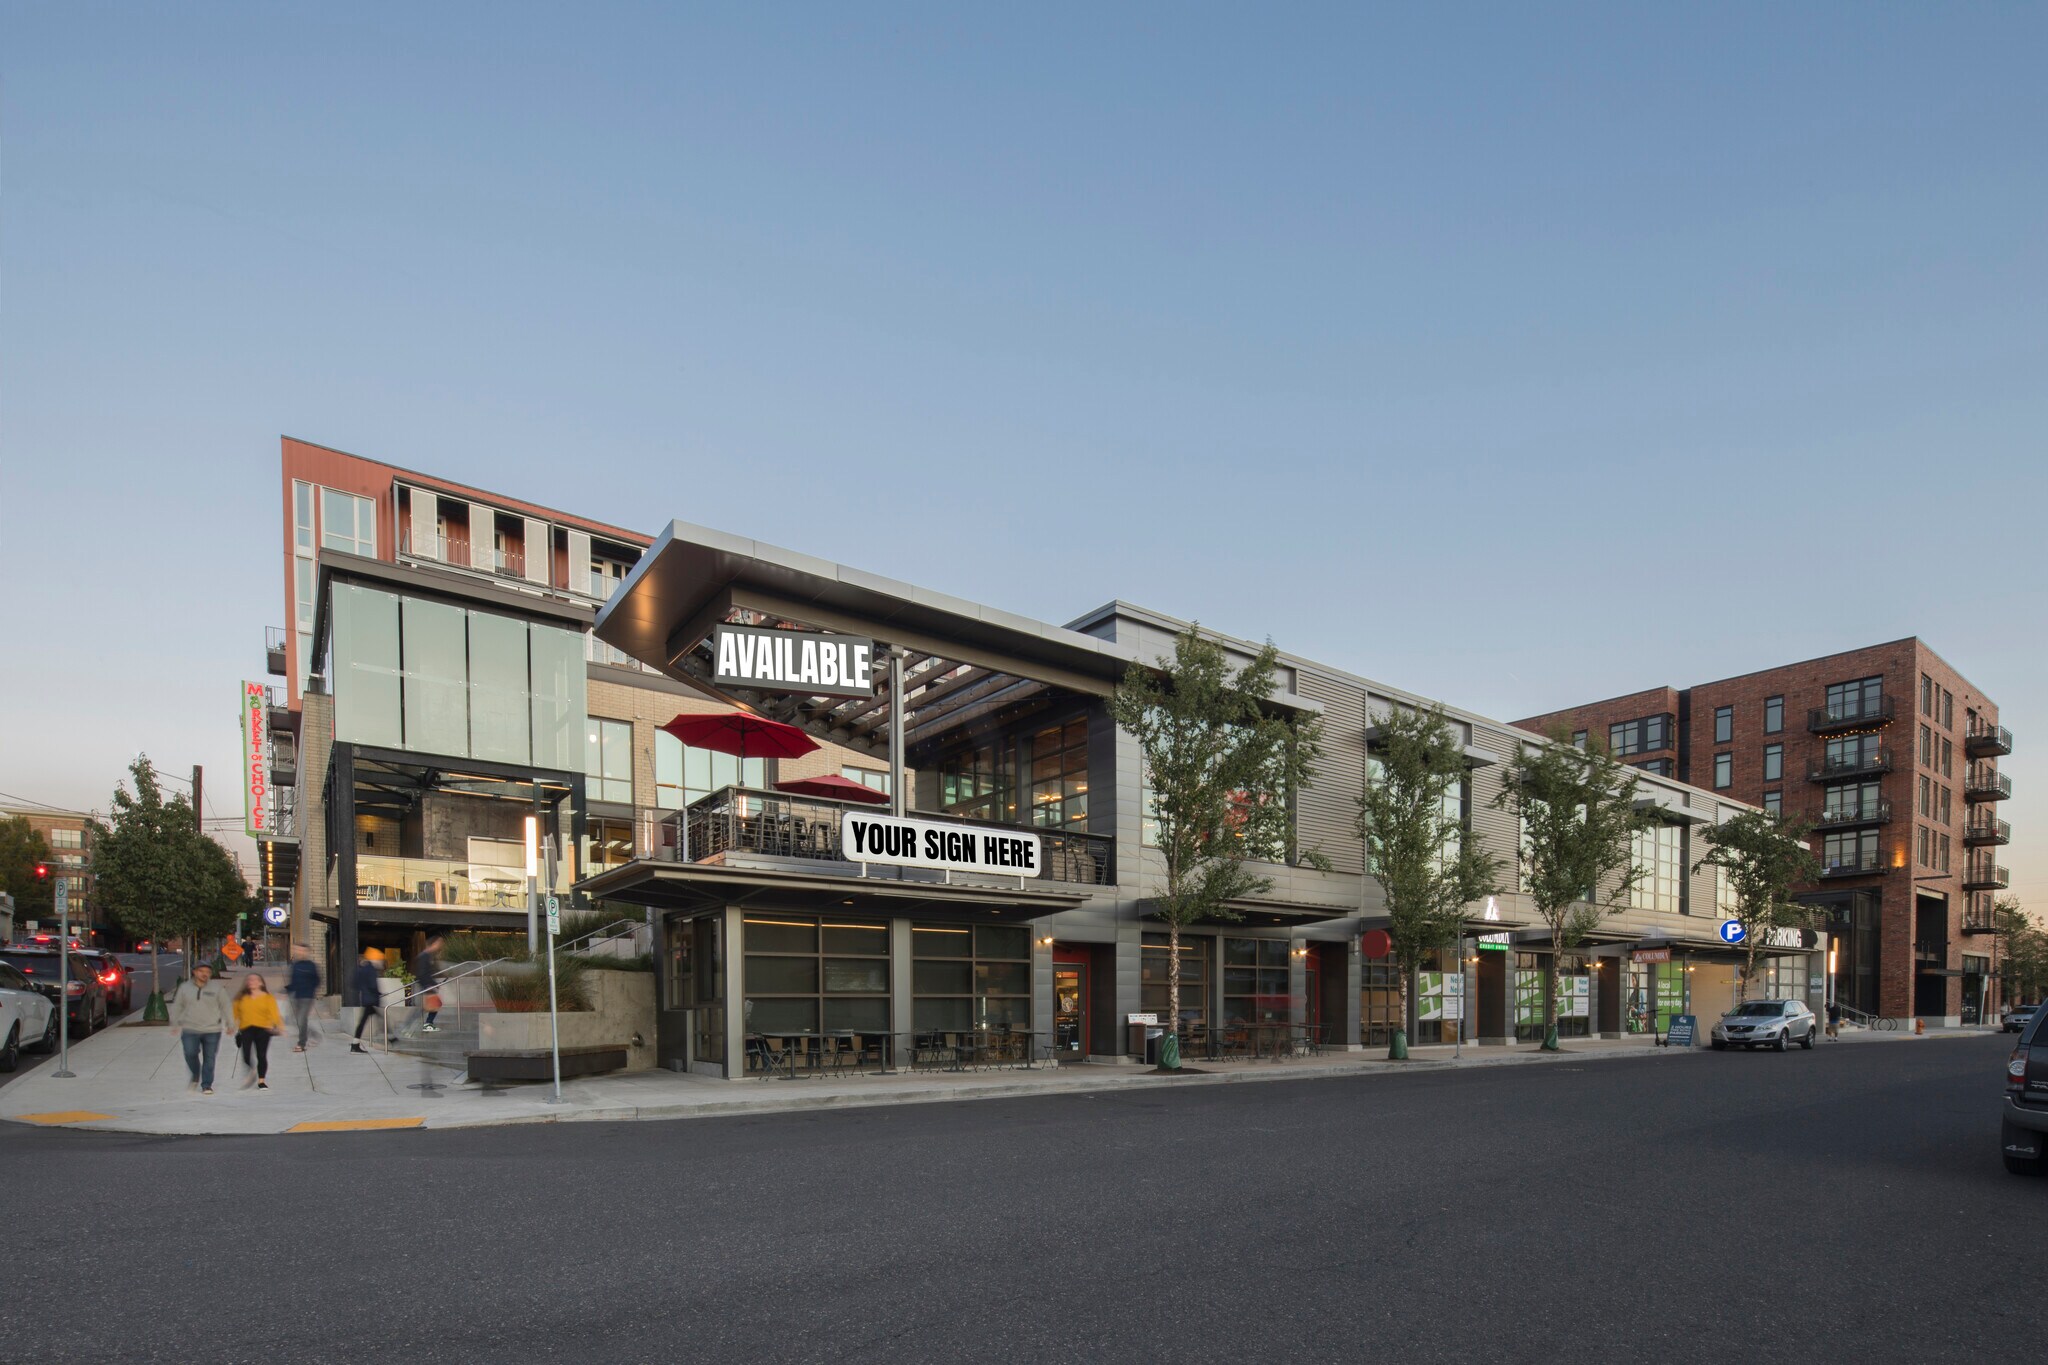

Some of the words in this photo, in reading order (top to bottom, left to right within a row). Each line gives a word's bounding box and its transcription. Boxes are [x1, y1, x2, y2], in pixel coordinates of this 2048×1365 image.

[718, 632, 870, 689] AVAILABLE
[251, 763, 265, 829] CHOICE
[851, 821, 917, 858] YOUR
[924, 829, 976, 863] SIGN
[984, 836, 1035, 869] HERE
[273, 910, 282, 919] P
[1727, 923, 1742, 940] P
[1766, 928, 1801, 948] PARKING
